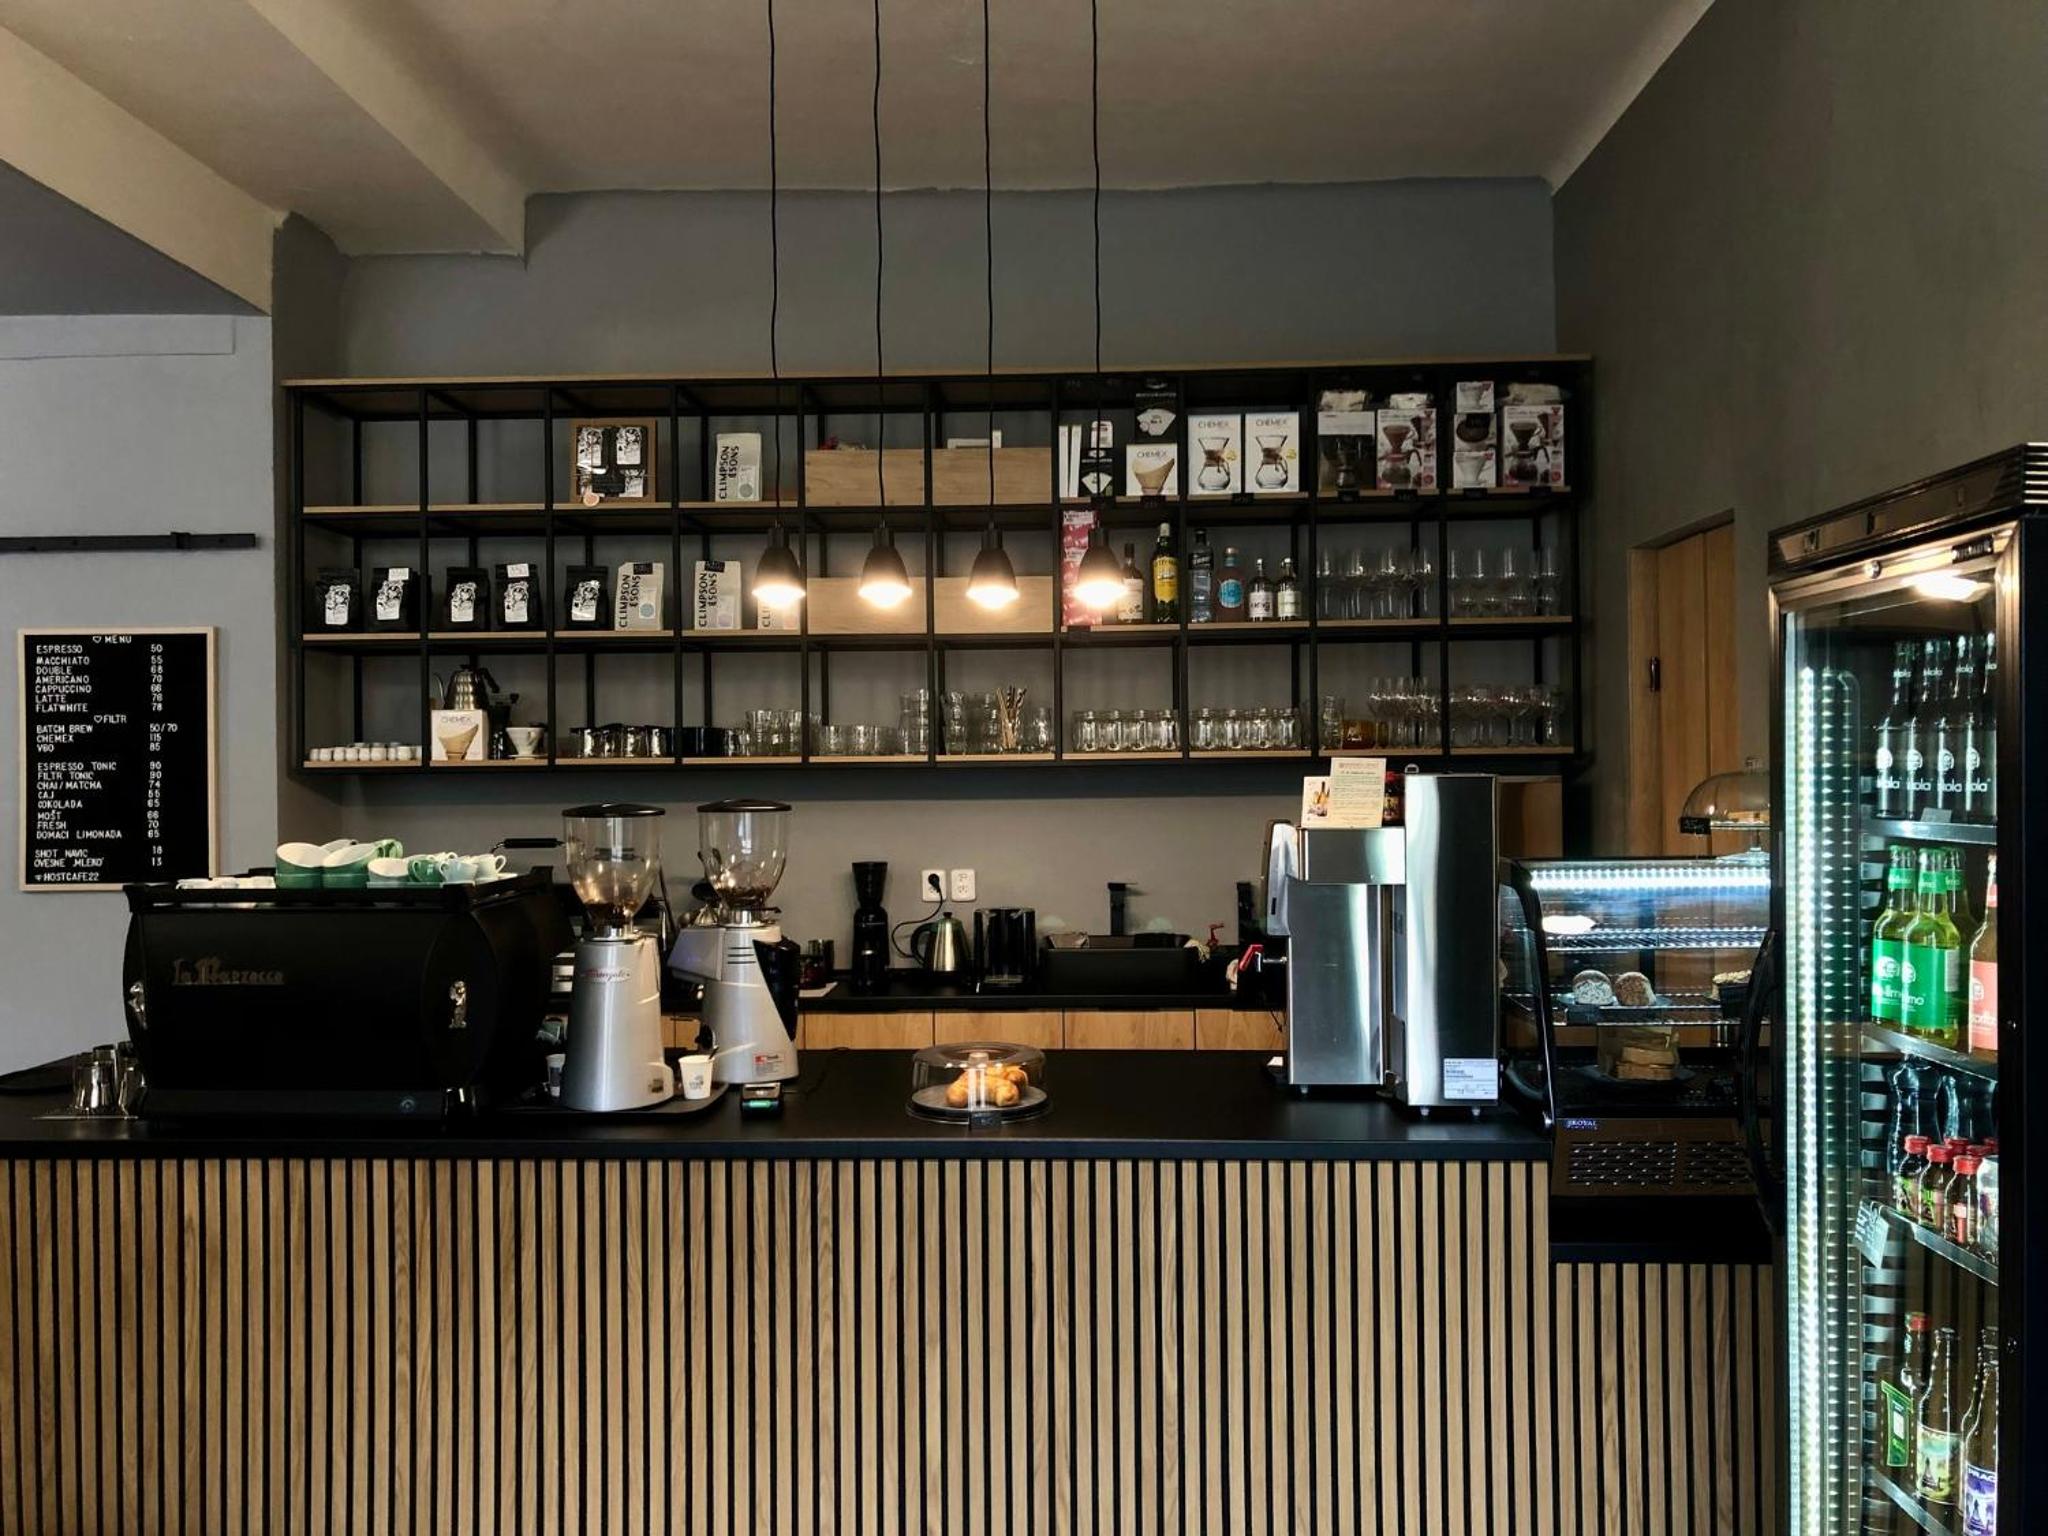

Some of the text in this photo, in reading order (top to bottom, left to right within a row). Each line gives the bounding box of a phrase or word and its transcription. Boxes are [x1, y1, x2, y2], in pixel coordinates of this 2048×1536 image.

[719, 445, 730, 500] CLIMPSON
[619, 574, 630, 628] CLIMPSON
[698, 572, 708, 627] CLIMPSON
[105, 635, 131, 643] MENU
[37, 644, 163, 654] ESPRESSO 50
[36, 656, 89, 665] MACCHIATO
[36, 666, 71, 675] DOUBLE
[36, 675, 89, 684] AMERICANO
[35, 685, 91, 693] CAPPUCCINO
[36, 694, 66, 703] LATTE
[36, 702, 88, 712] FLATWHITE
[104, 715, 126, 723] FILTR
[37, 725, 65, 733] BATCH
[69, 725, 93, 733] BREW
[37, 734, 73, 743] CHEMEX
[37, 744, 54, 752] V60
[38, 762, 84, 772] ESPRESSO
[91, 762, 116, 770] TONIC
[38, 771, 62, 780] FILTR
[69, 771, 94, 780] TONIC
[38, 810, 61, 820] MOŠT
[37, 820, 159, 830] FRESH 70
[77, 830, 122, 839] LIMONADA
[35, 849, 57, 858] SHOT
